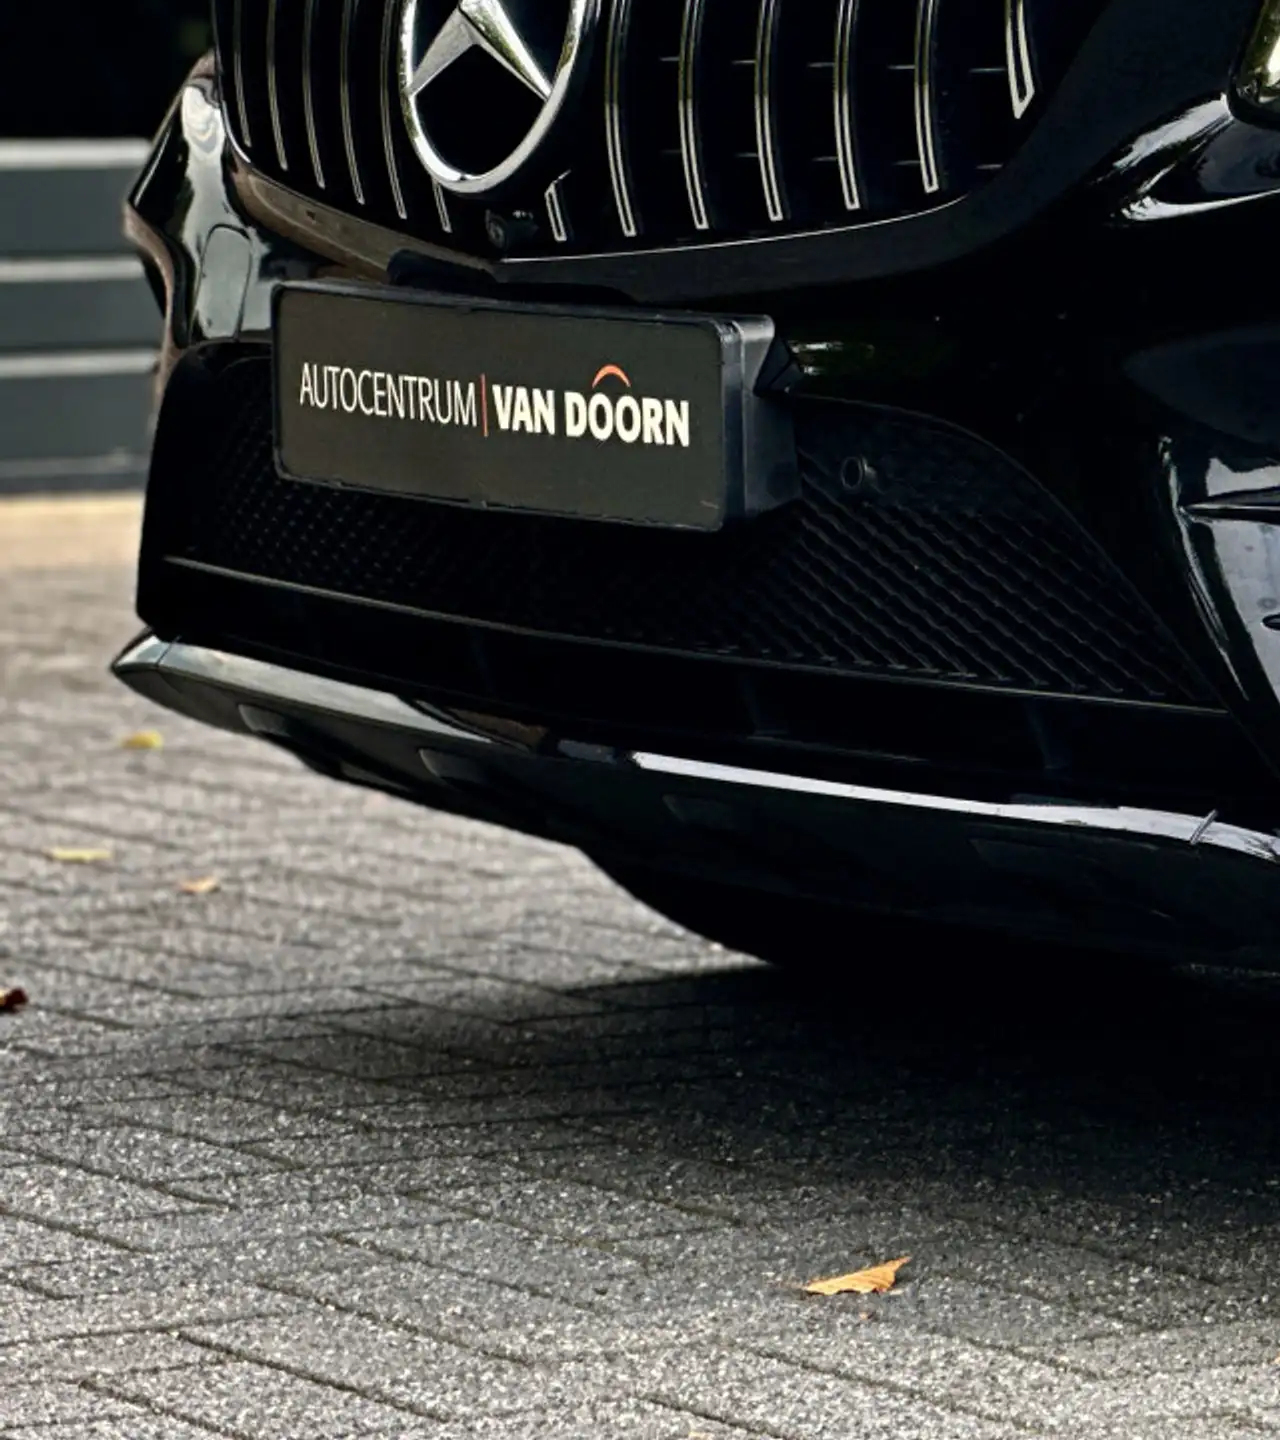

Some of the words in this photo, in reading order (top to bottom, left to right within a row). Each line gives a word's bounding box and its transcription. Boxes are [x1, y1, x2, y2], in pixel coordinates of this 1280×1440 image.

[299, 361, 477, 428] AUTOCENTRUM
[491, 383, 555, 436] VAN
[563, 390, 691, 448] DOORN
